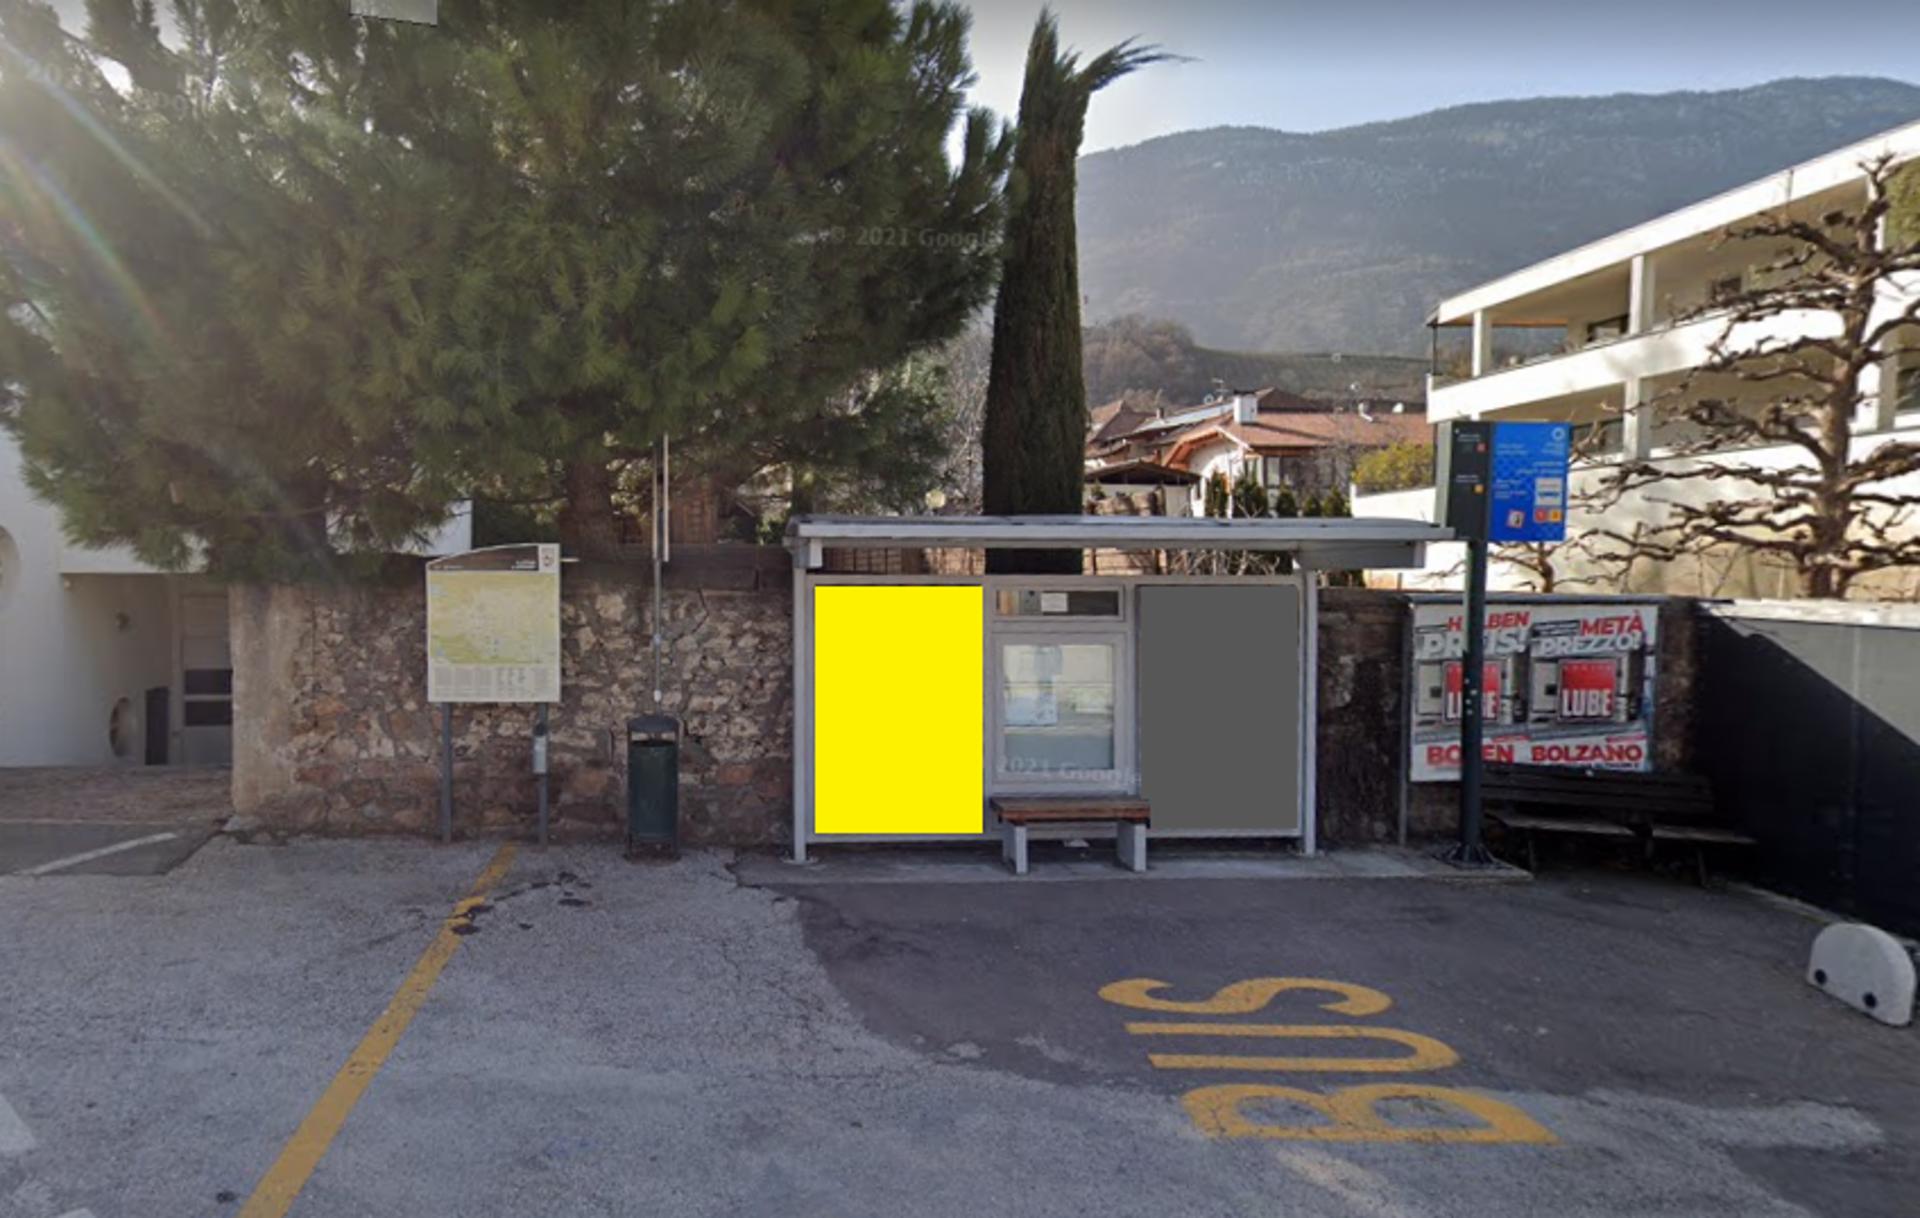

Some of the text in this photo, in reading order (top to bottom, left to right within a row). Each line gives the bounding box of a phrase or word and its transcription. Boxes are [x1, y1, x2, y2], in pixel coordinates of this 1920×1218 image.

[1447, 611, 1531, 632] HBEN
[1581, 609, 1644, 636] METÀ
[1421, 630, 1529, 656] PRIS!
[1541, 631, 1642, 656] PREZZO!
[1562, 689, 1613, 716] LUBE
[1426, 744, 1643, 766] BOEN BOLZANO
[1098, 977, 1562, 1145] BUS
